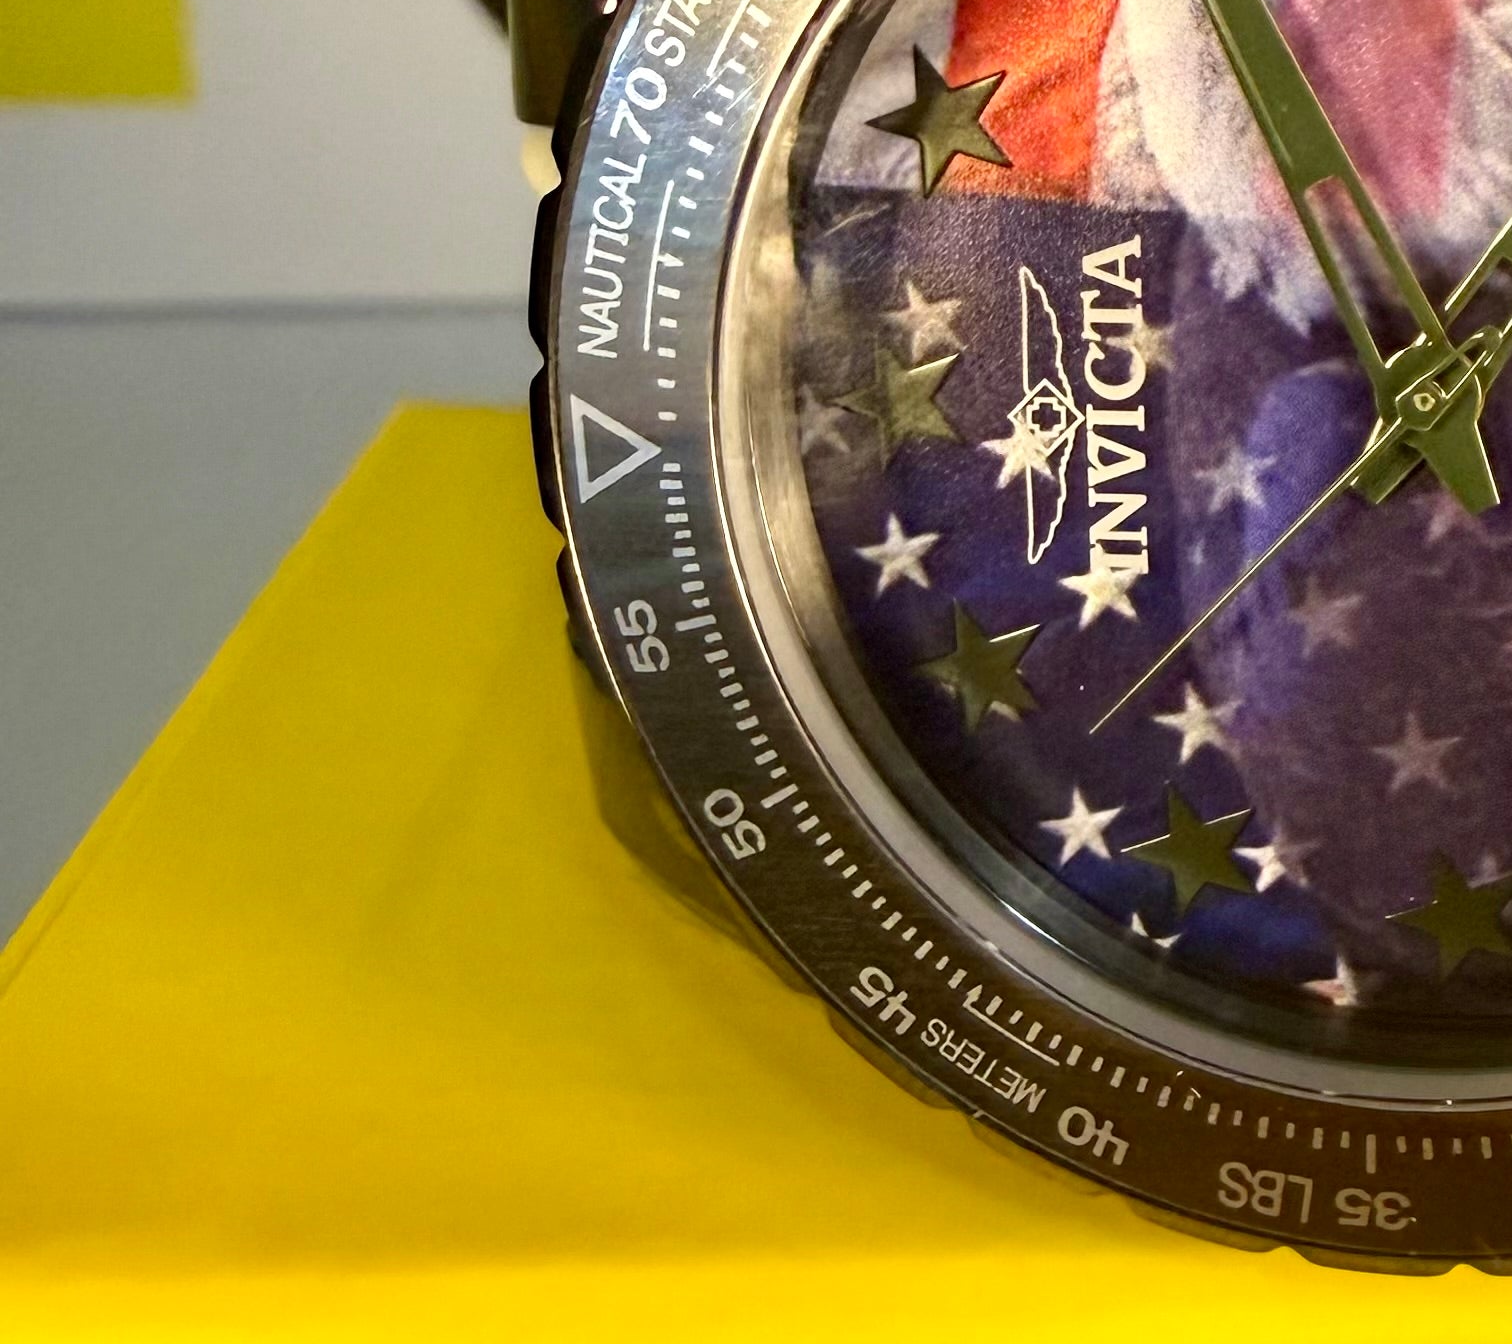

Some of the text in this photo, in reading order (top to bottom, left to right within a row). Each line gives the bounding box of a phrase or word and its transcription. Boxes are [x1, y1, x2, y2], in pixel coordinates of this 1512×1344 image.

[610, 66, 667, 145] 70
[577, 153, 647, 359] NAUTICAL
[1080, 234, 1148, 575] INVICTA
[614, 599, 670, 673] 55
[704, 788, 766, 860] 50
[850, 966, 916, 1035] 45
[920, 1018, 1047, 1113] METERS
[1057, 1106, 1130, 1165] 40
[1218, 1161, 1412, 1230] 35 LBS
